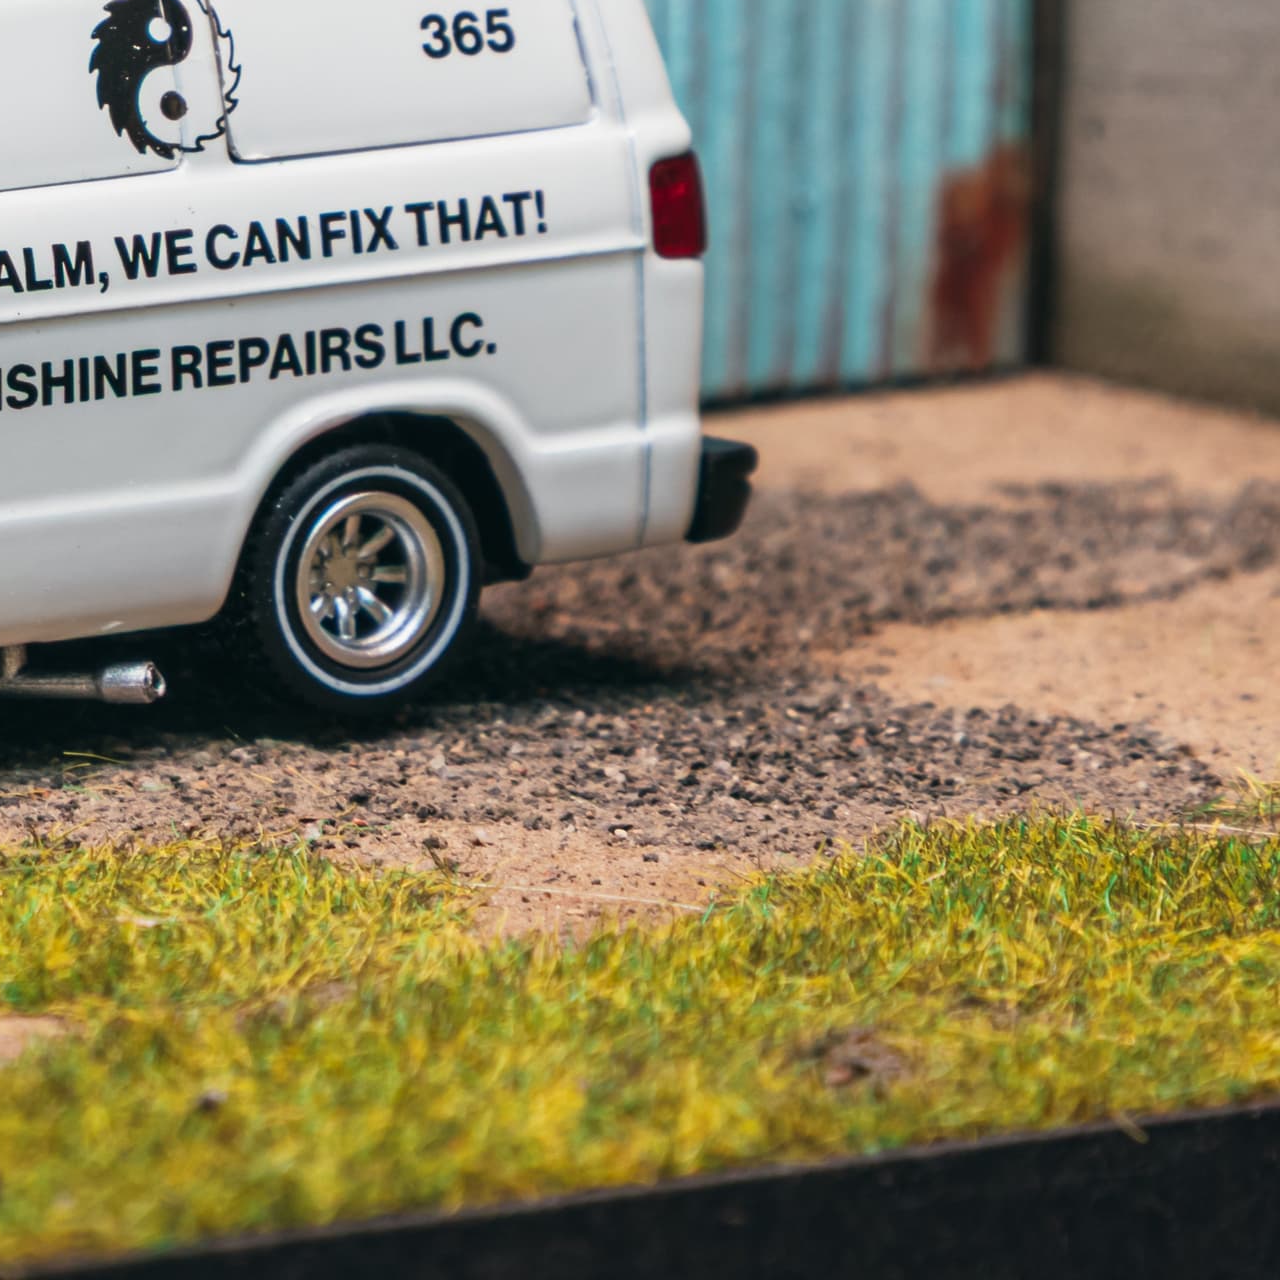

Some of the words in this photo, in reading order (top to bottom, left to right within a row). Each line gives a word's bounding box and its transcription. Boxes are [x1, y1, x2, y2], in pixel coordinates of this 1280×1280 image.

[420, 8, 516, 60] 365
[114, 228, 198, 280] WE
[204, 215, 311, 271] CAN
[319, 206, 400, 258] FIX
[404, 190, 548, 247] THAT!
[170, 323, 387, 393] REPAIRS
[393, 312, 498, 367] LLC.
